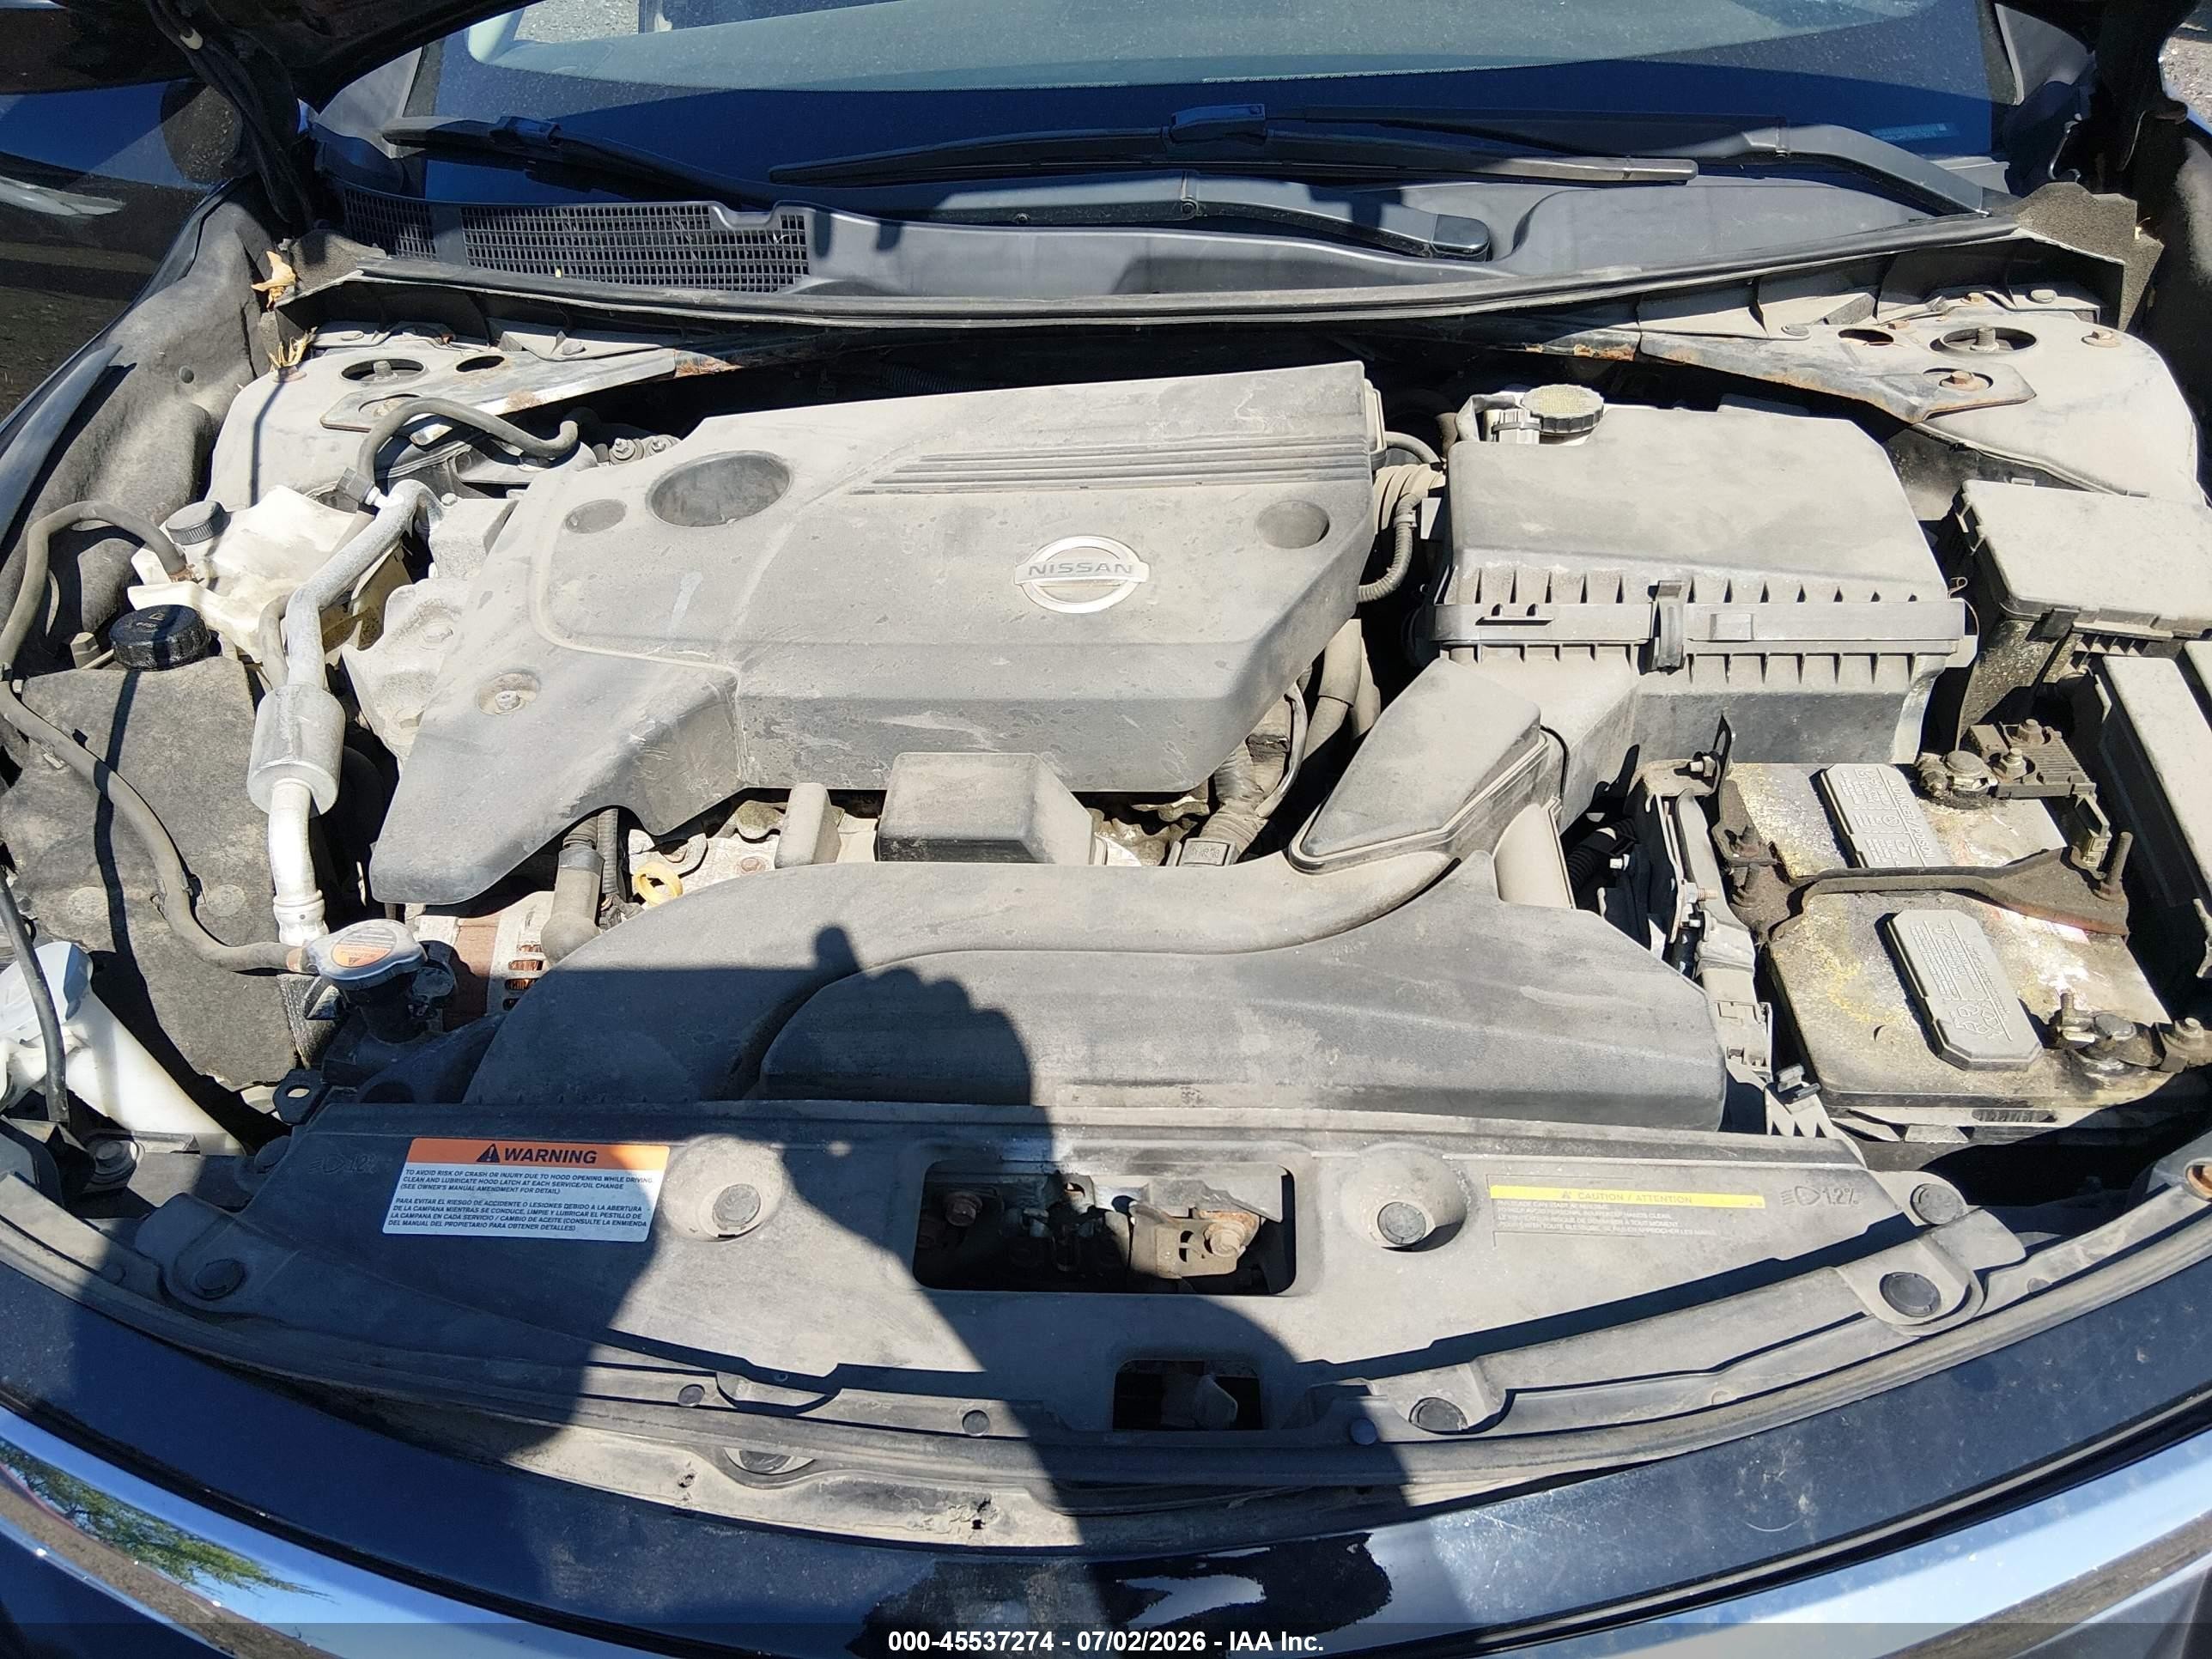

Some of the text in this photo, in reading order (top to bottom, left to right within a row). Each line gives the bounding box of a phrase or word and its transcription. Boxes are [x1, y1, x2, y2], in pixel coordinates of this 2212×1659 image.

[1028, 562, 1133, 577] NISSAN
[1891, 788, 1916, 820] DANGER
[1911, 826, 1936, 859] POISON
[505, 1147, 598, 1164] WARNING
[1578, 1193, 1624, 1201] CAUTION
[1635, 1194, 1692, 1204] ATTENTION
